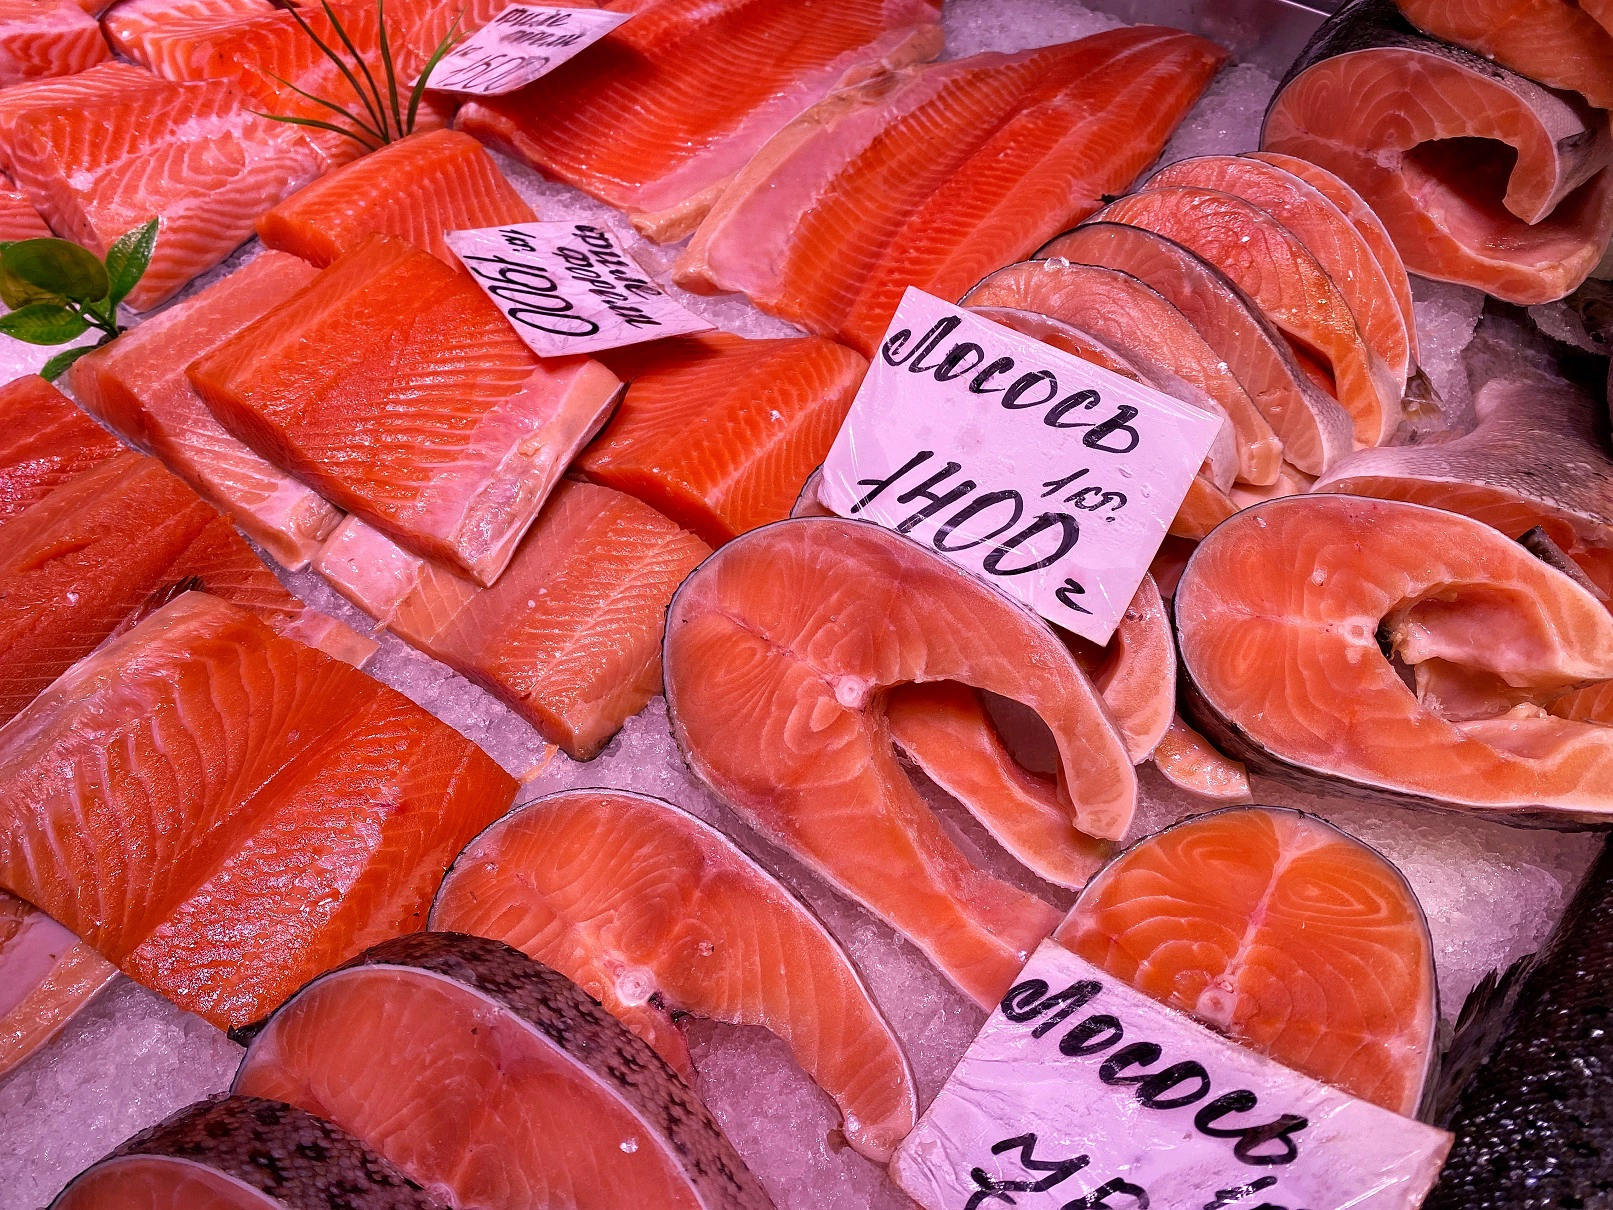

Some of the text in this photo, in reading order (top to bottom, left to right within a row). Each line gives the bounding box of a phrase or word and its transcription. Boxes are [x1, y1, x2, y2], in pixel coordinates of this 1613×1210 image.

[463, 254, 600, 338] 1900
[881, 315, 1140, 454] Лосось
[850, 450, 1081, 577] 1400
[1000, 977, 1309, 1167] Лосось
